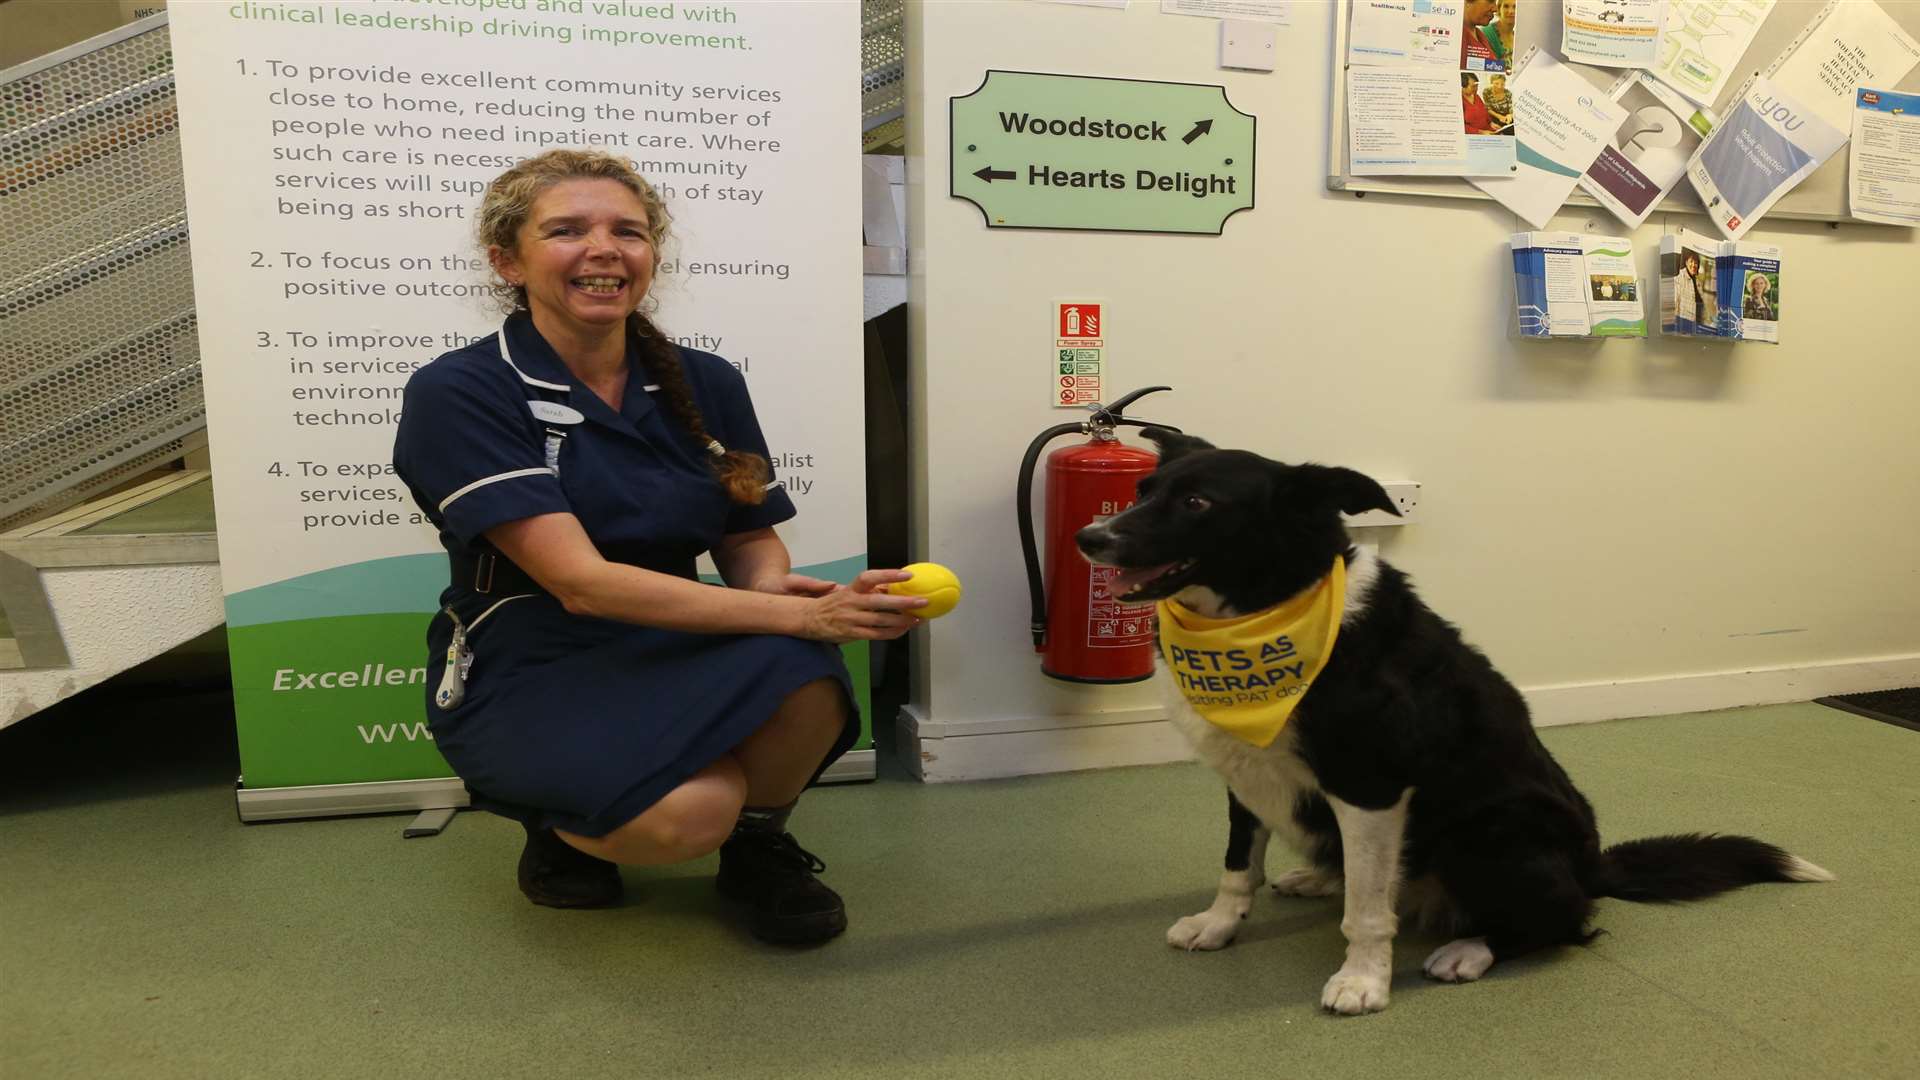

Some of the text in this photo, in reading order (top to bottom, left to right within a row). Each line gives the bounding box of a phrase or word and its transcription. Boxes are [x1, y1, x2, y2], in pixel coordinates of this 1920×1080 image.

[592, 1, 674, 19] valued
[684, 7, 736, 23] with
[229, 5, 323, 24] clinical
[336, 8, 474, 37] leadership
[483, 18, 572, 44] driving
[583, 24, 753, 50] improvement.
[1833, 39, 1874, 79] INDEPENDENT
[1838, 52, 1860, 77] MENTAL
[1854, 48, 1866, 58] THE
[237, 59, 782, 103] 1. To provide excellent community services
[1818, 72, 1842, 96] SERVICE
[1820, 63, 1852, 94] ADVOCACY
[1831, 59, 1856, 84] HEALTH
[269, 88, 771, 127] close to home, reducing the number of
[1758, 96, 1804, 131] you
[272, 119, 781, 152] people who need inpatient care. Where
[998, 112, 1167, 141] Woodstock
[1570, 122, 1582, 132] Act
[273, 144, 332, 162] such
[342, 149, 397, 164] care
[407, 148, 425, 165] is
[275, 172, 377, 190] services
[386, 175, 431, 192] will
[685, 184, 710, 200] of
[718, 185, 763, 205] stay
[1029, 165, 1236, 198] Hearts Delight
[278, 197, 353, 220] being
[364, 204, 389, 217] as
[399, 202, 464, 219] short
[250, 251, 272, 268] 2.
[280, 253, 312, 270] To
[321, 252, 390, 270] focus
[400, 256, 431, 270] on
[441, 254, 482, 271] the
[689, 260, 790, 280] ensuring
[284, 280, 386, 298] positive
[257, 332, 278, 348] 3.
[286, 332, 318, 348] To
[328, 332, 433, 351] improve
[291, 358, 313, 374] in
[323, 358, 420, 374] services
[267, 462, 289, 477] 4.
[297, 461, 328, 477] To
[300, 486, 403, 502] services,
[304, 509, 400, 531] provide
[1114, 606, 1120, 615] 3
[1170, 635, 1294, 671] PETS AS
[1178, 660, 1304, 692] THERAPY
[1236, 690, 1269, 703] PAT
